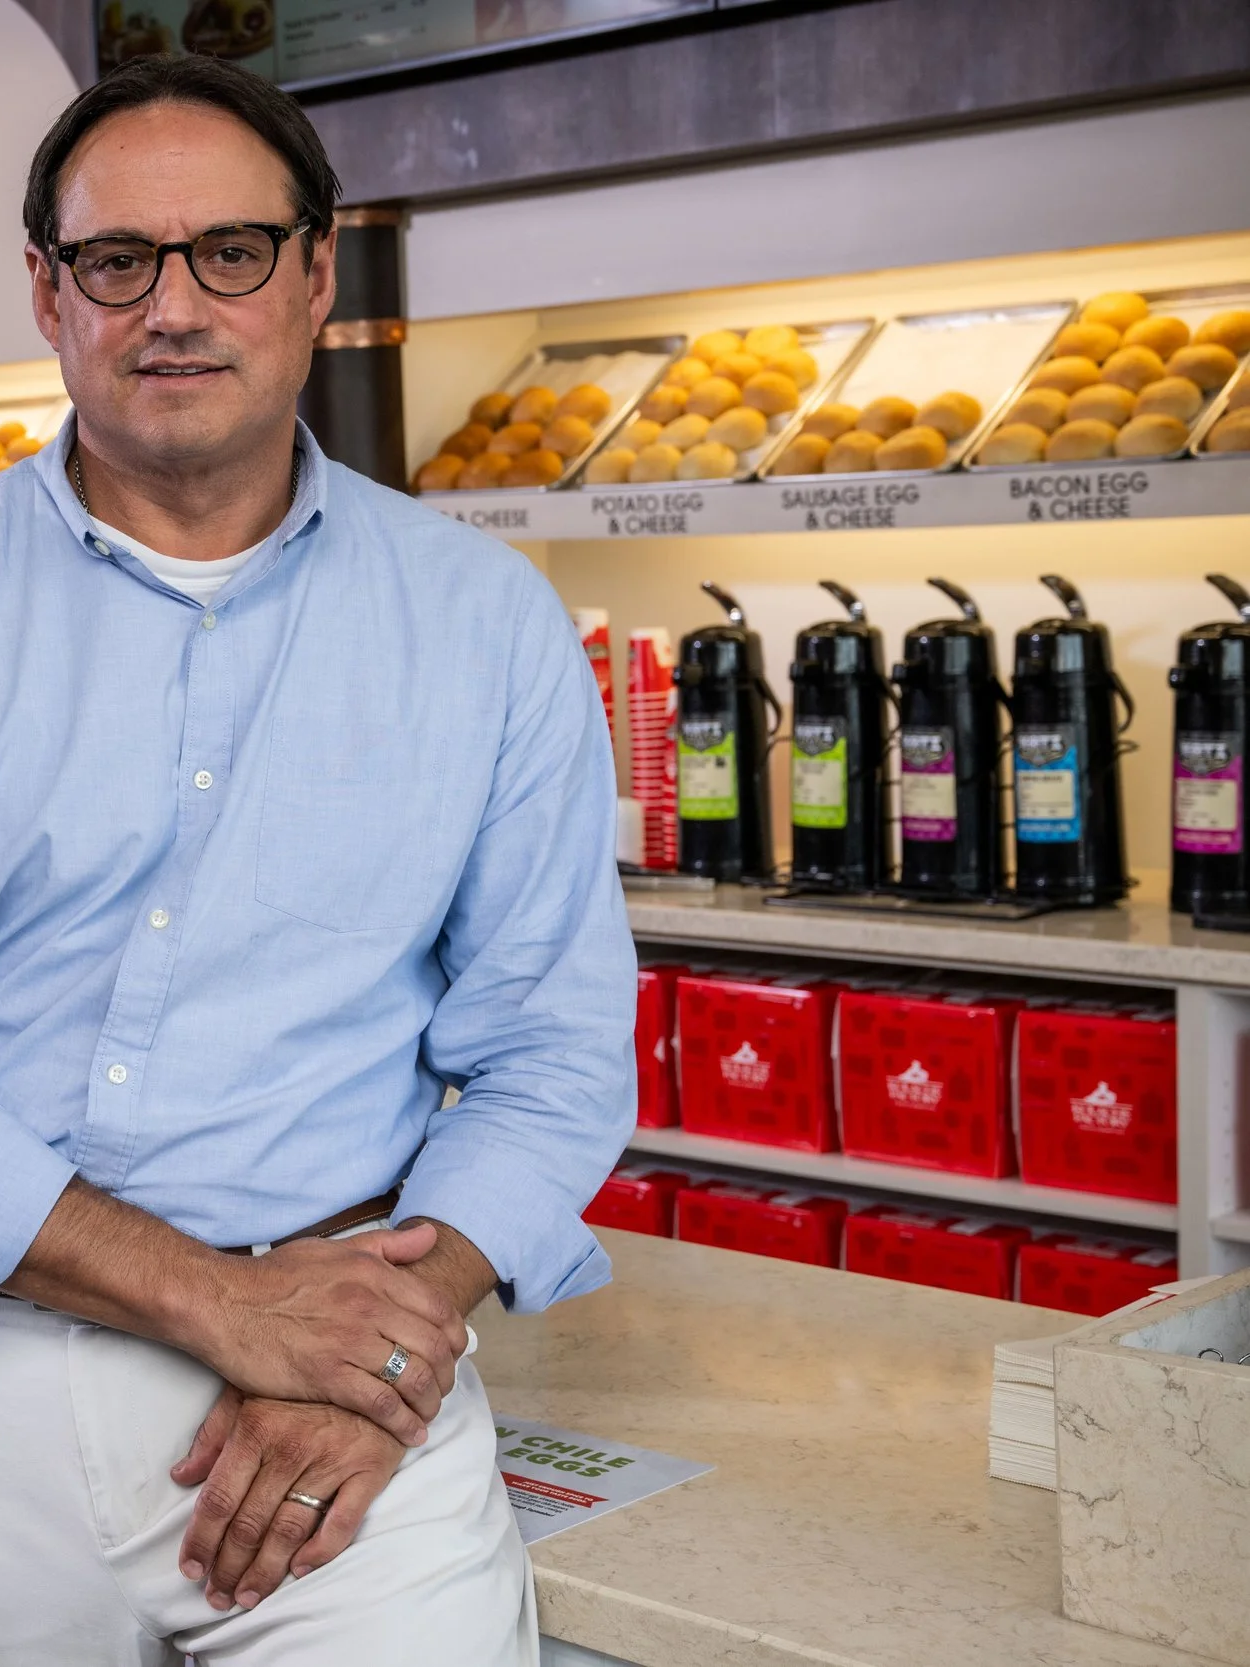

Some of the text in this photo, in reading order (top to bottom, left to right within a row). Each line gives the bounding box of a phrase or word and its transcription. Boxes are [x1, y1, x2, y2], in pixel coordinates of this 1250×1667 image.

[781, 483, 920, 510] SAUSAGE EGG
[1009, 470, 1148, 499] BACON EGG
[591, 491, 704, 515] POTATO EGG
[1028, 495, 1130, 521] & CHEESE
[470, 508, 529, 529] CHEESE
[608, 514, 688, 535] & CHEESE
[805, 507, 894, 530] & CHEESE
[502, 1447, 610, 1478] EGGS
[520, 1436, 636, 1469] CHILE
